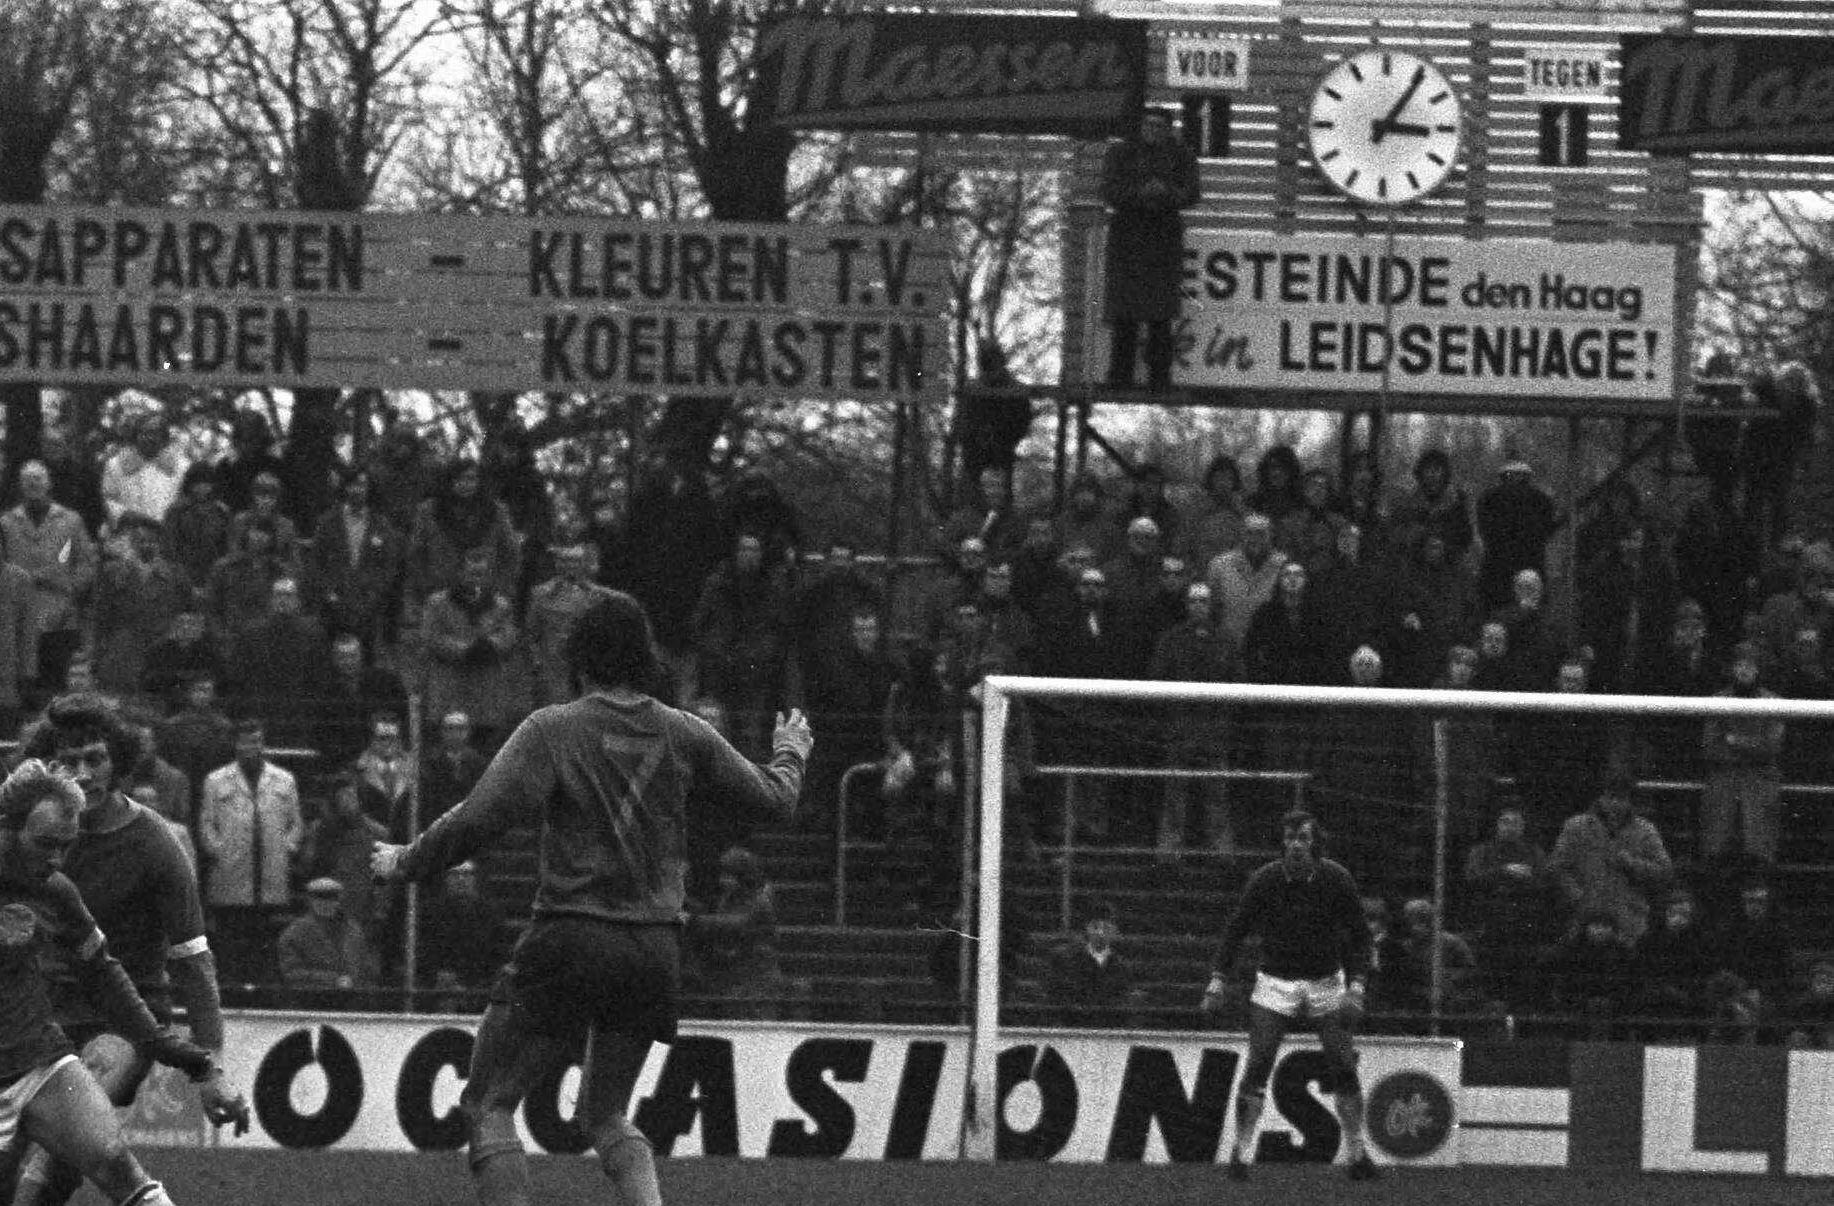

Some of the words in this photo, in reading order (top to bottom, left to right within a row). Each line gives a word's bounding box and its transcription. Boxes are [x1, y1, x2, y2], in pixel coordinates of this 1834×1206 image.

[760, 17, 1127, 112] Maessen
[1175, 49, 1239, 79] VOOR
[1530, 60, 1602, 89] TEGEN
[1197, 99, 1212, 154] 1
[1553, 112, 1570, 165] 1
[529, 230, 788, 300] KLEUREN
[828, 237, 926, 305] T.V.
[1463, 271, 1533, 311] den
[1540, 273, 1643, 321] Haag
[542, 314, 925, 389] KOELKASTEN
[1278, 318, 1658, 382] LEIDSENHAGE!
[601, 732, 666, 827] 7
